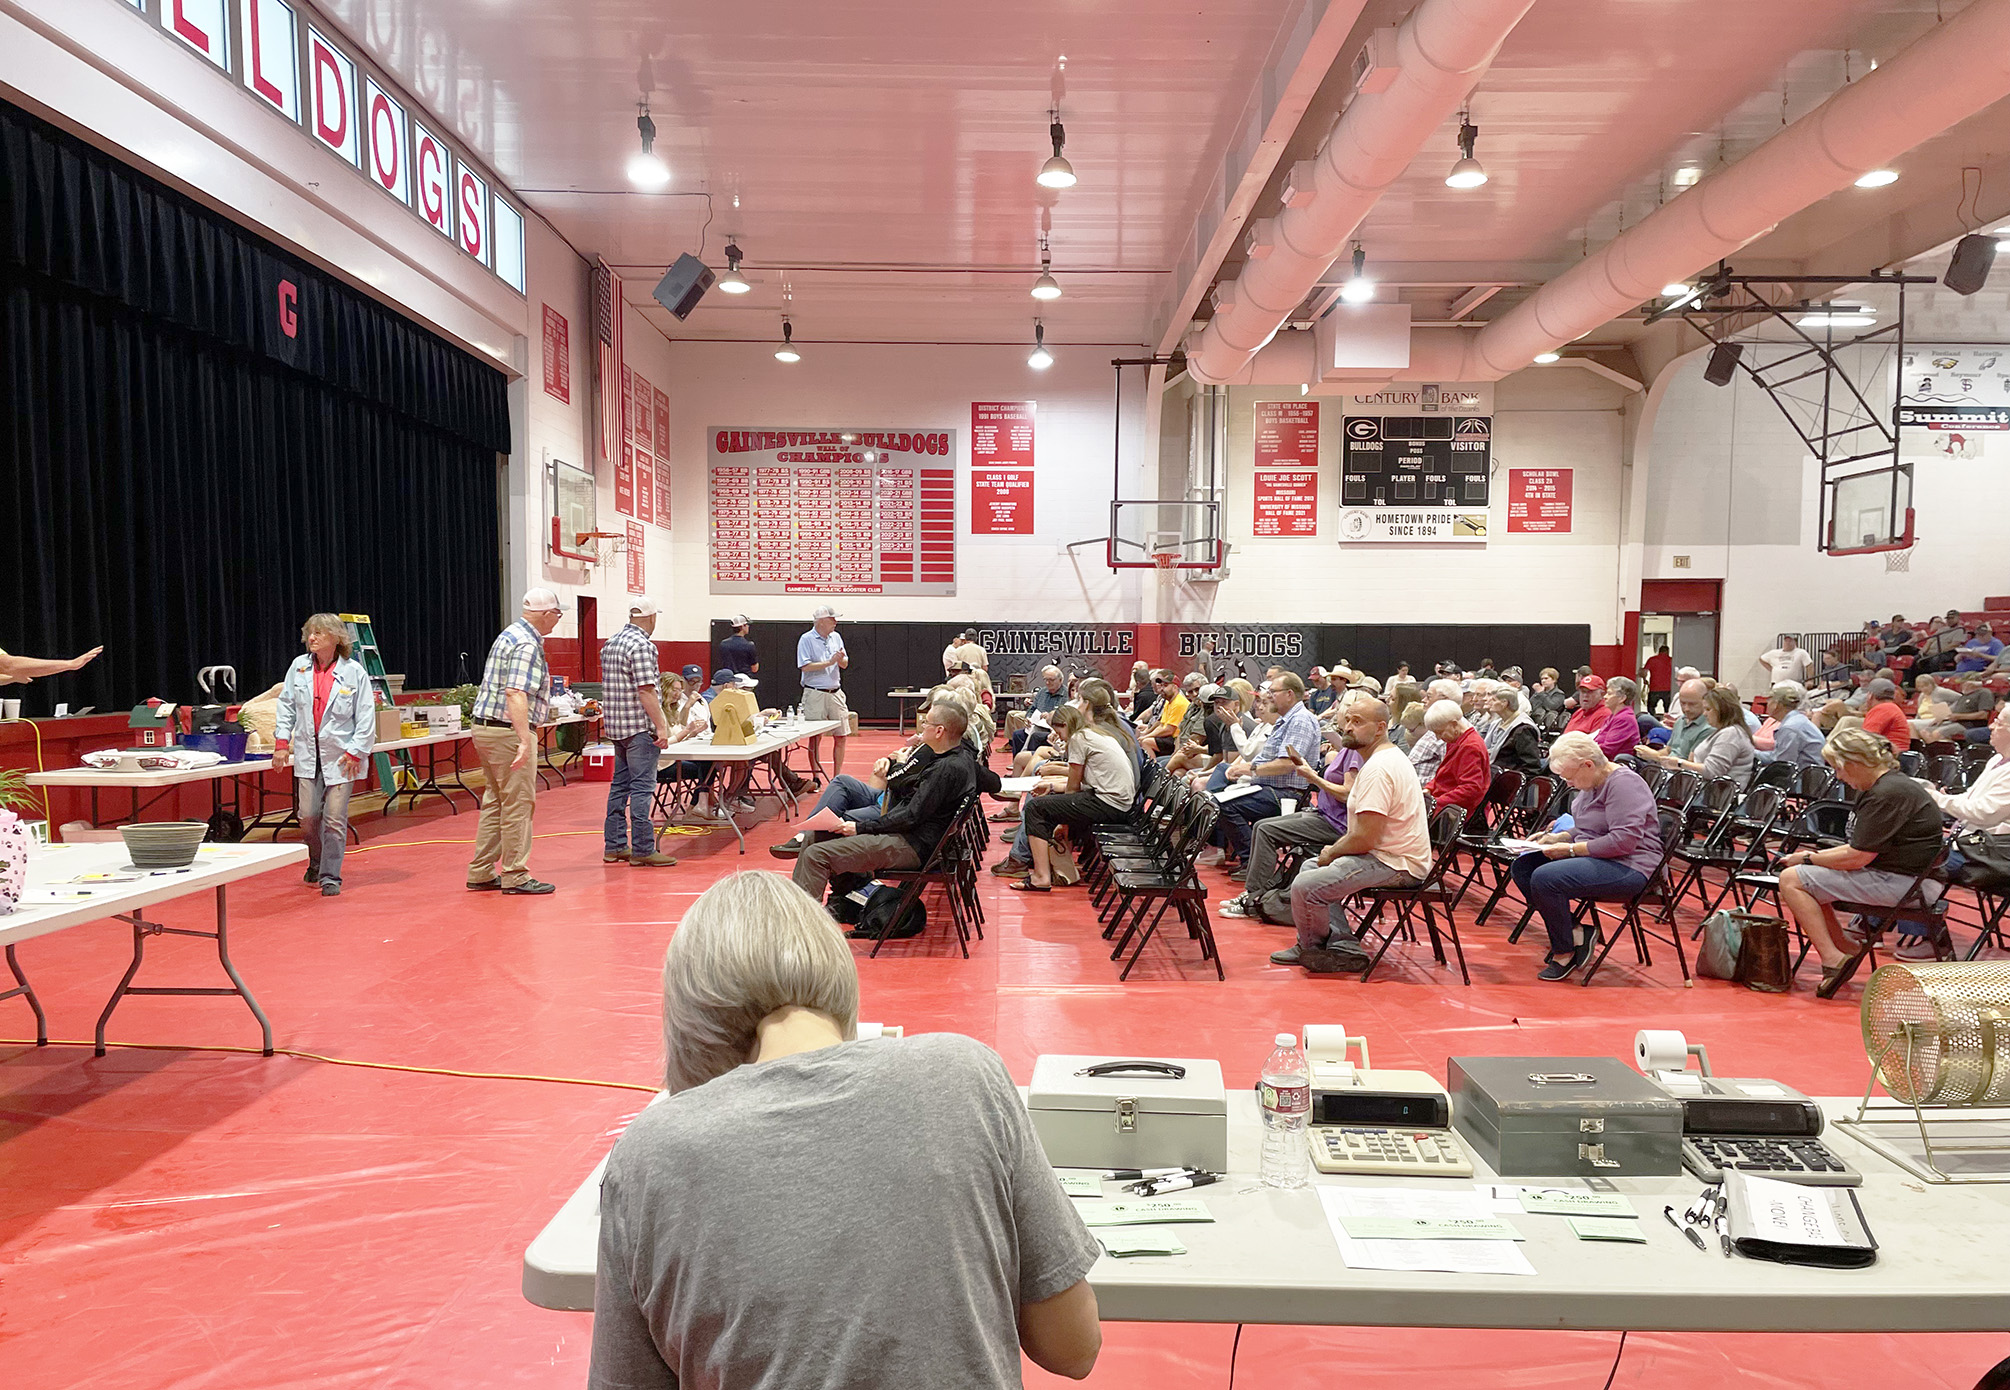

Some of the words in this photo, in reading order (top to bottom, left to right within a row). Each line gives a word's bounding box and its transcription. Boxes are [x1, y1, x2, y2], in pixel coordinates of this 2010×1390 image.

[278, 279, 298, 339] G
[1354, 392, 1420, 404] CENTURY
[1441, 392, 1480, 404] BANK
[1900, 411, 2008, 423] Summit
[716, 430, 842, 454] GAINESVILLE
[850, 432, 949, 456] BULLDOGS
[1350, 442, 1384, 450] BULLDOGS
[1451, 442, 1486, 451] VISITOR
[1376, 514, 1423, 524] HOMETOWN
[1426, 514, 1451, 524] PRIDE
[1389, 526, 1413, 536] SINCE
[1417, 526, 1437, 536] 1894
[1676, 558, 1688, 567] EXIT
[979, 630, 1133, 655] GAINESVILLE
[1179, 632, 1302, 657] BULLDOGS
